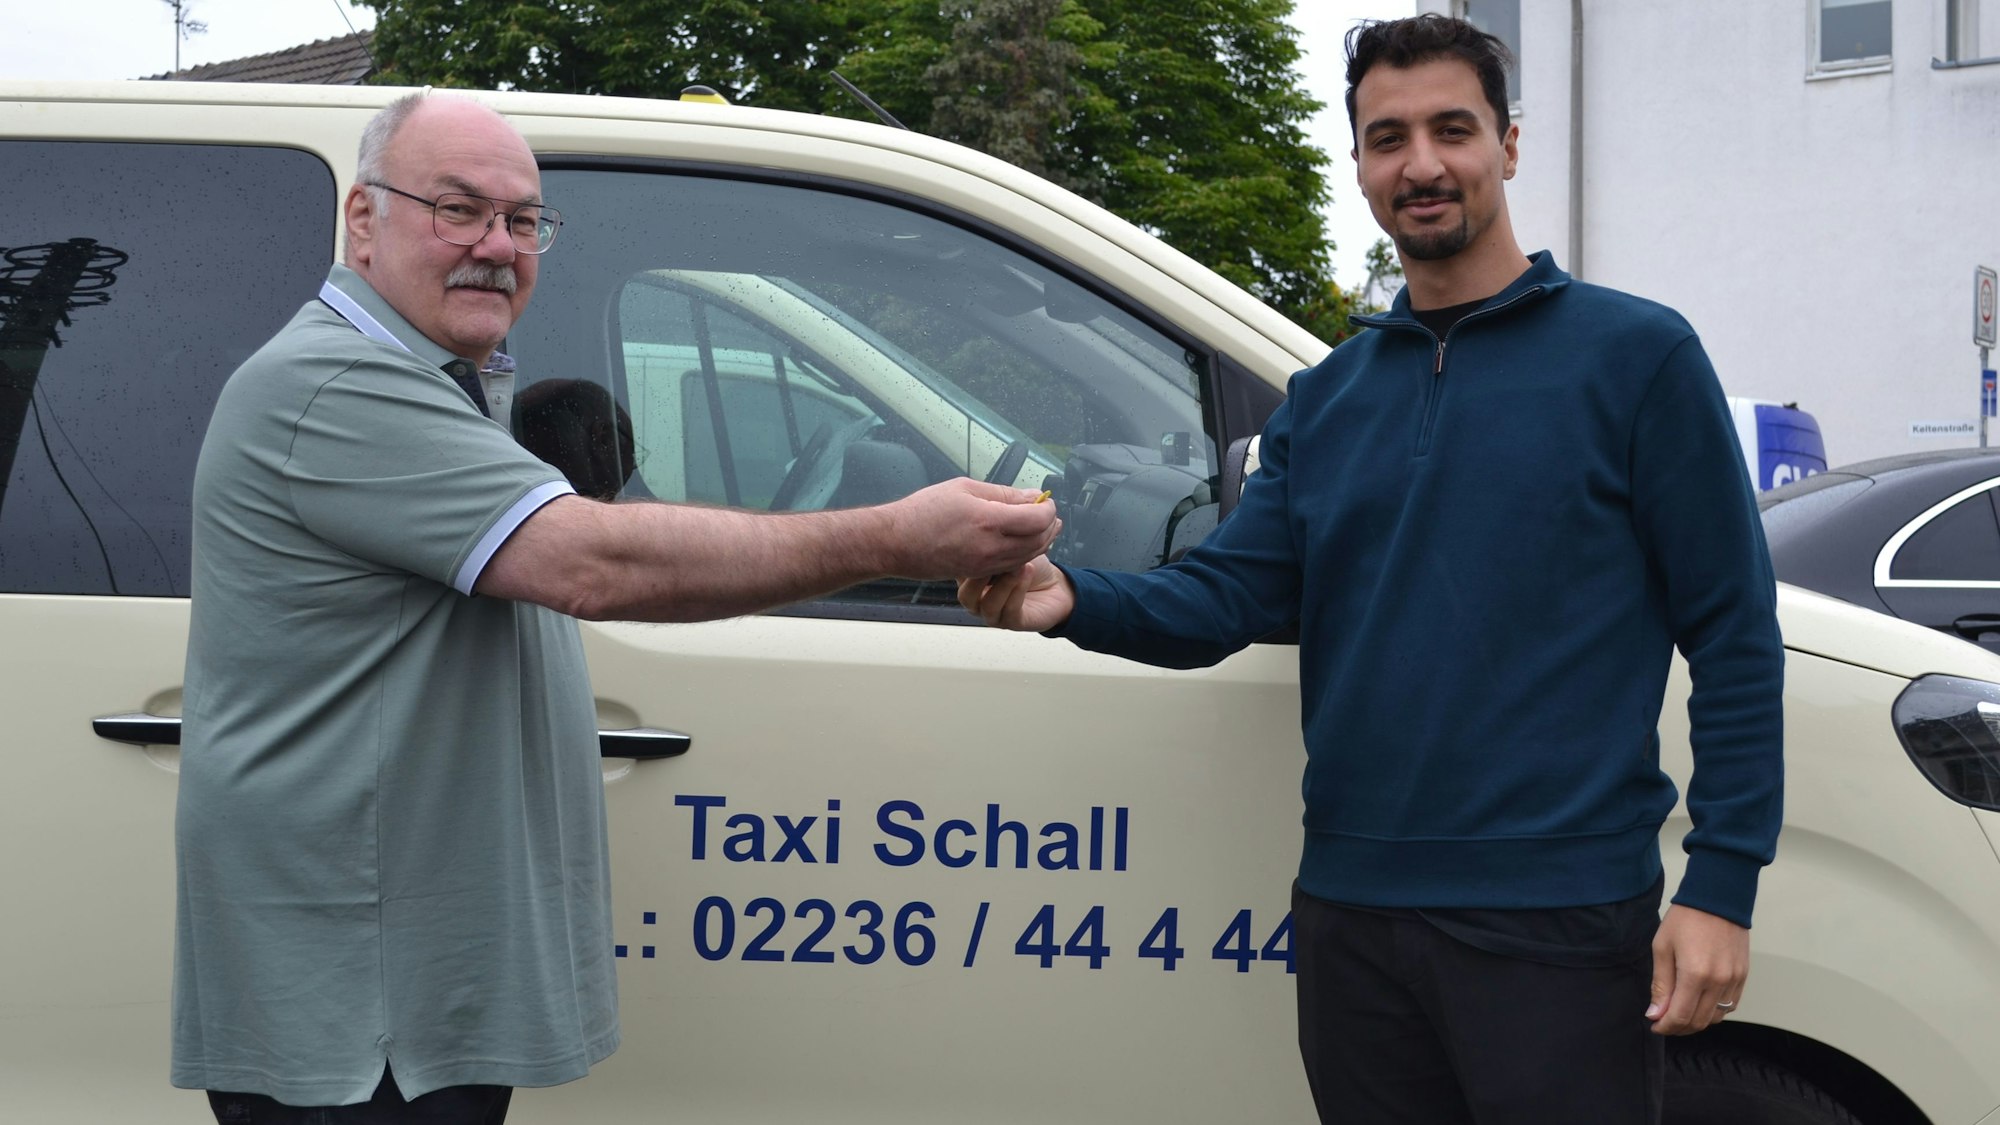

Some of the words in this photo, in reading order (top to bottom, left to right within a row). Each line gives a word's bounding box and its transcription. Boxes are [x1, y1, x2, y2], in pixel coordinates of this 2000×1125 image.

[674, 794, 841, 864] Taxi
[874, 799, 1129, 872] Schall
[692, 896, 936, 967] 02236
[964, 902, 990, 968] /
[1014, 904, 1111, 970] 44
[1138, 907, 1185, 972] 4
[1212, 909, 1297, 974] 44
